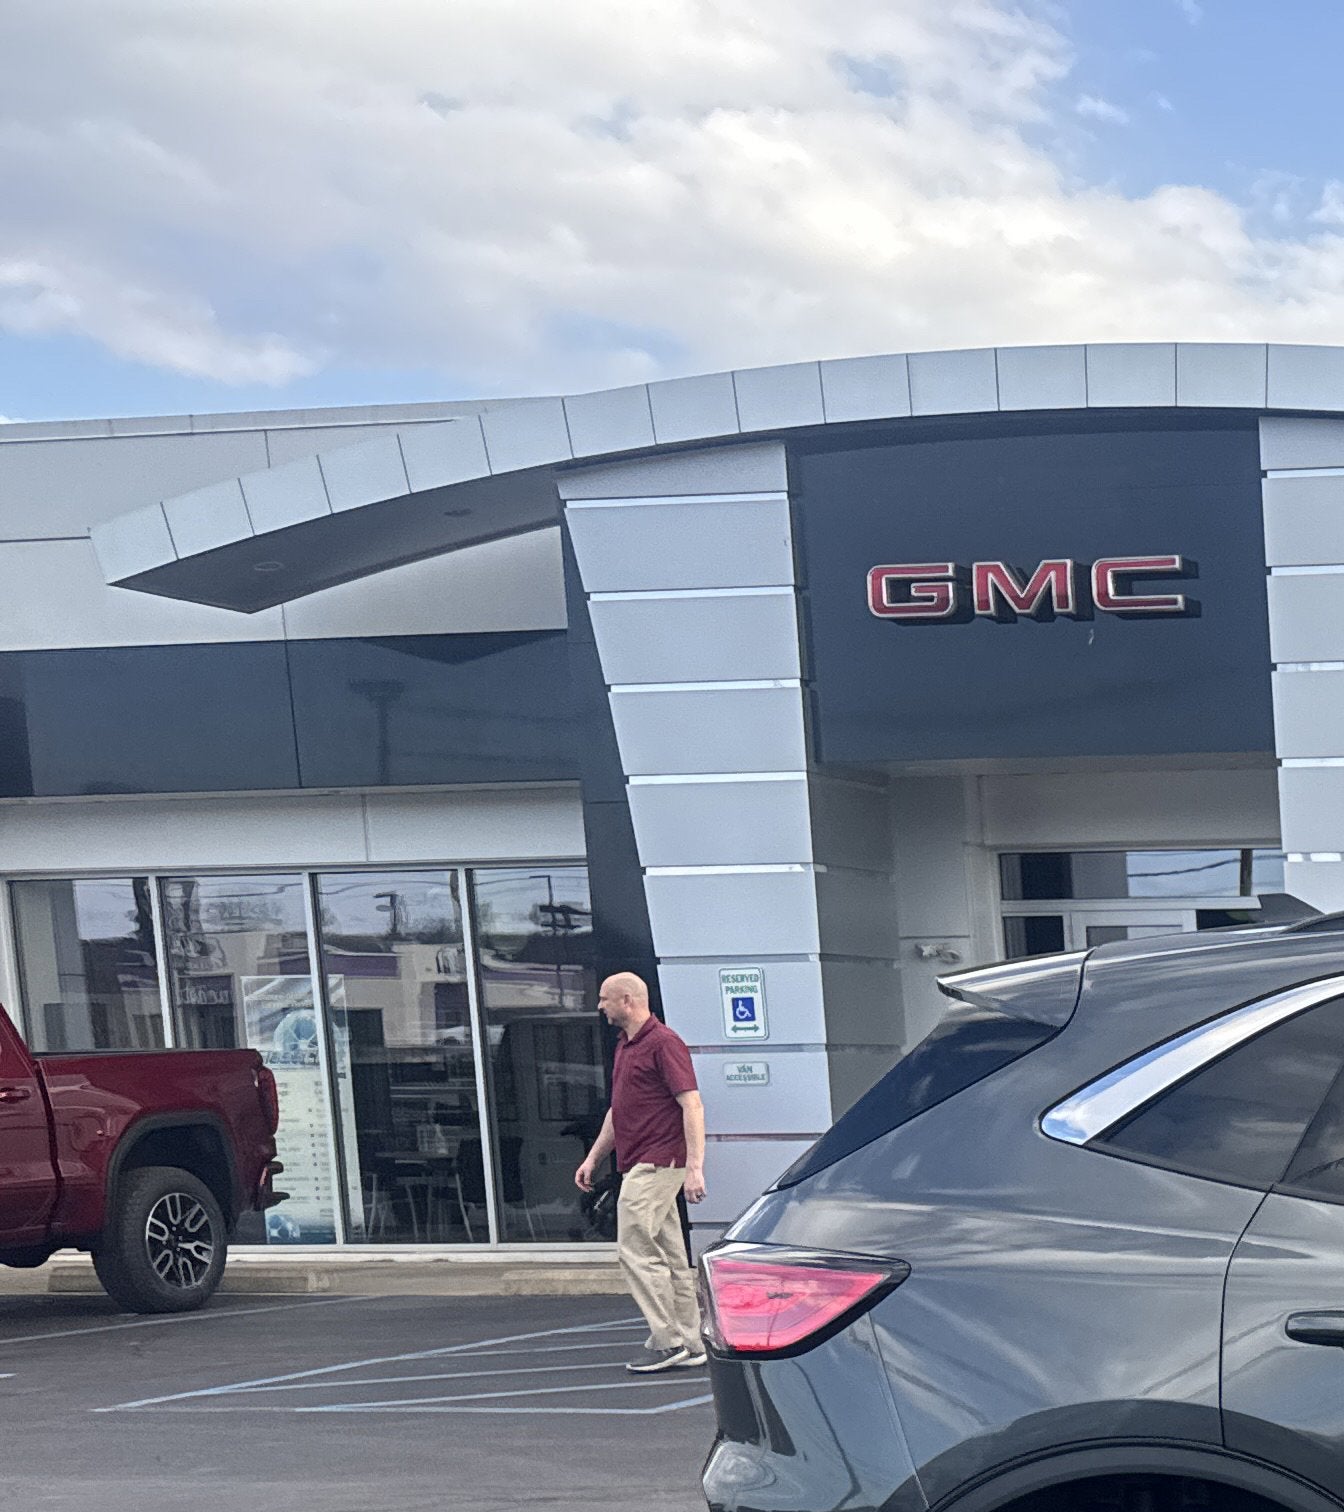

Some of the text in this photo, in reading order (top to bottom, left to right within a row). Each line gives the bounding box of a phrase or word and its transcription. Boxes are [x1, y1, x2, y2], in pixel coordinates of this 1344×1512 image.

[867, 555, 1186, 617] GMC
[722, 974, 759, 983] RESERVED
[725, 985, 758, 995] PARKING
[736, 1065, 753, 1074] VAN
[726, 1073, 766, 1082] ACCESSIBLE
